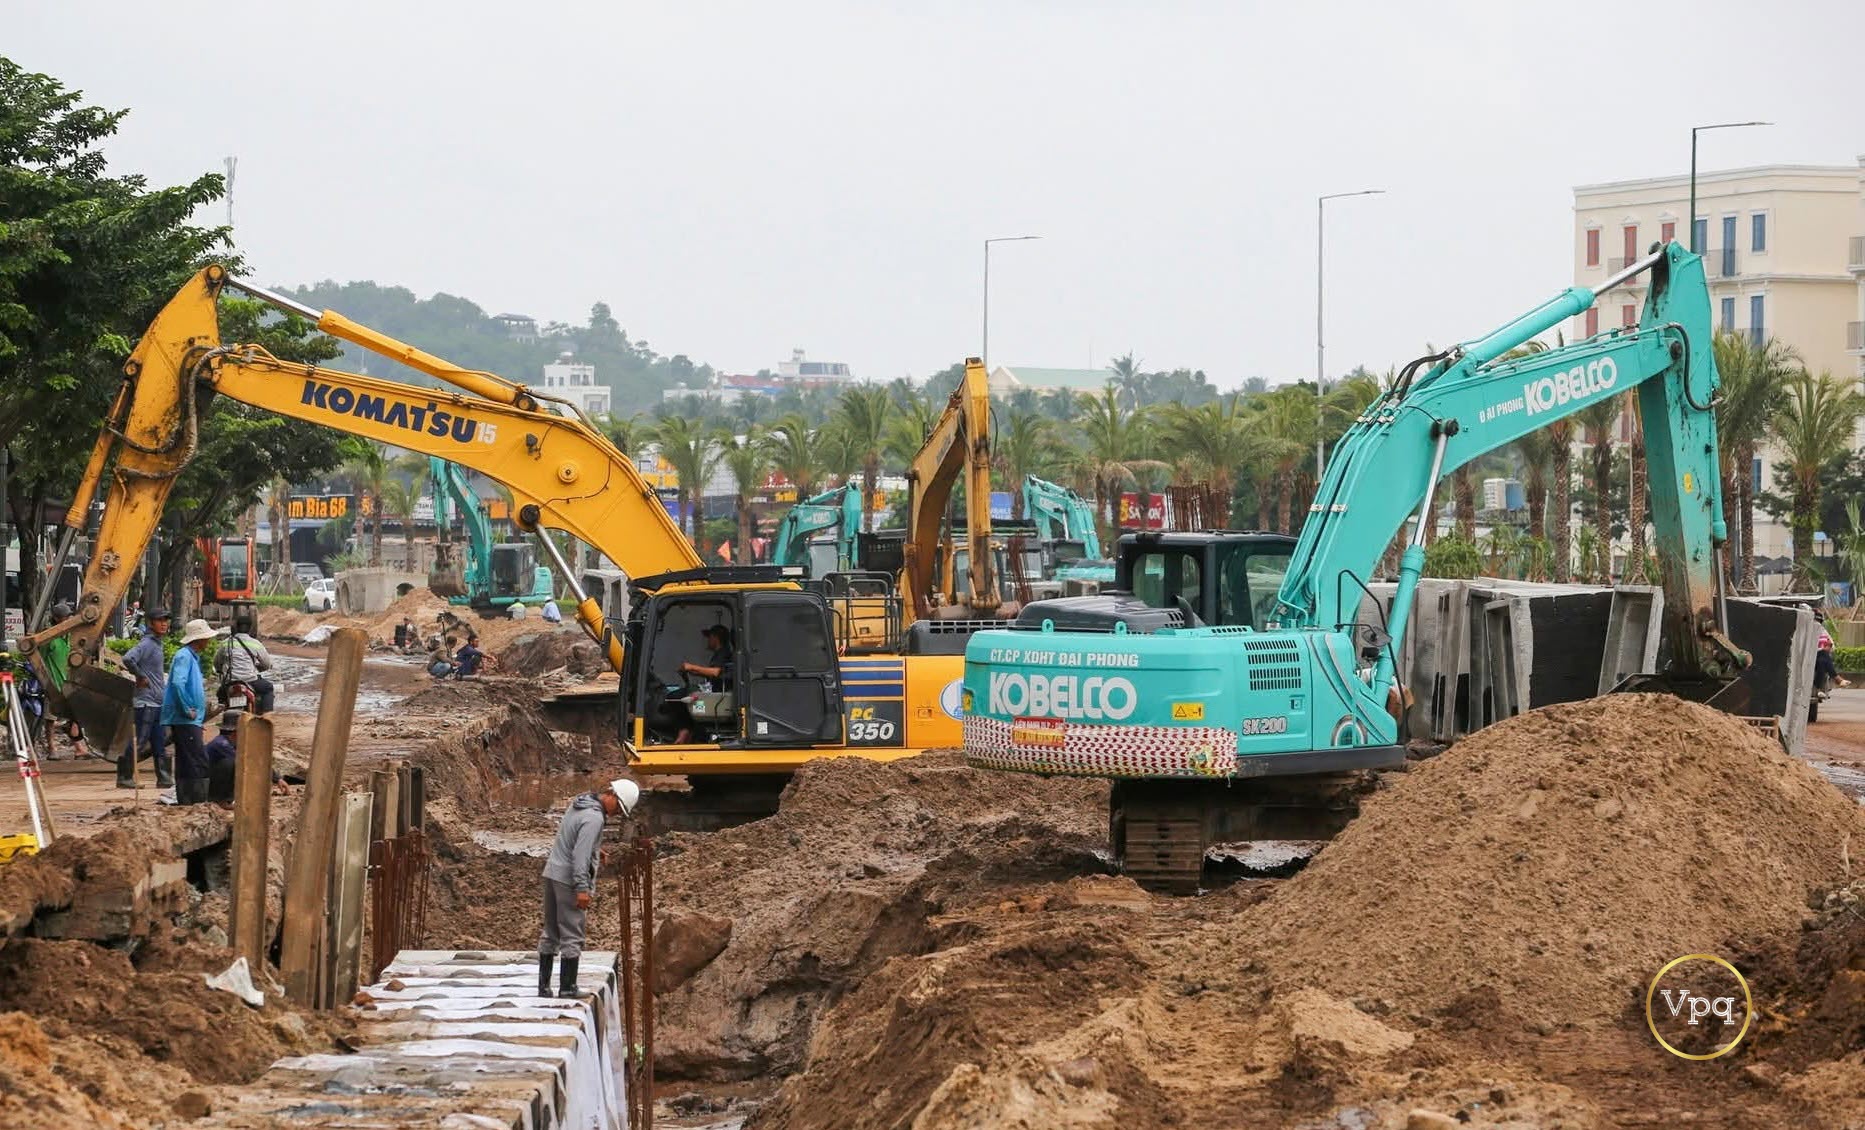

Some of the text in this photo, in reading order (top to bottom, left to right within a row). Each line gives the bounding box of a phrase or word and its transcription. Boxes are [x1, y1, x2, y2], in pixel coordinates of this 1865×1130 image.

[1524, 357, 1617, 416] KOBELCO
[301, 380, 477, 443] KOMATSU
[477, 423, 497, 444] 15
[306, 497, 328, 517] Bia
[1086, 654, 1139, 667] PHONG
[989, 672, 1137, 720] KOBELCO
[850, 707, 874, 720] PC
[849, 722, 895, 740] 350
[1242, 716, 1287, 735] SK200
